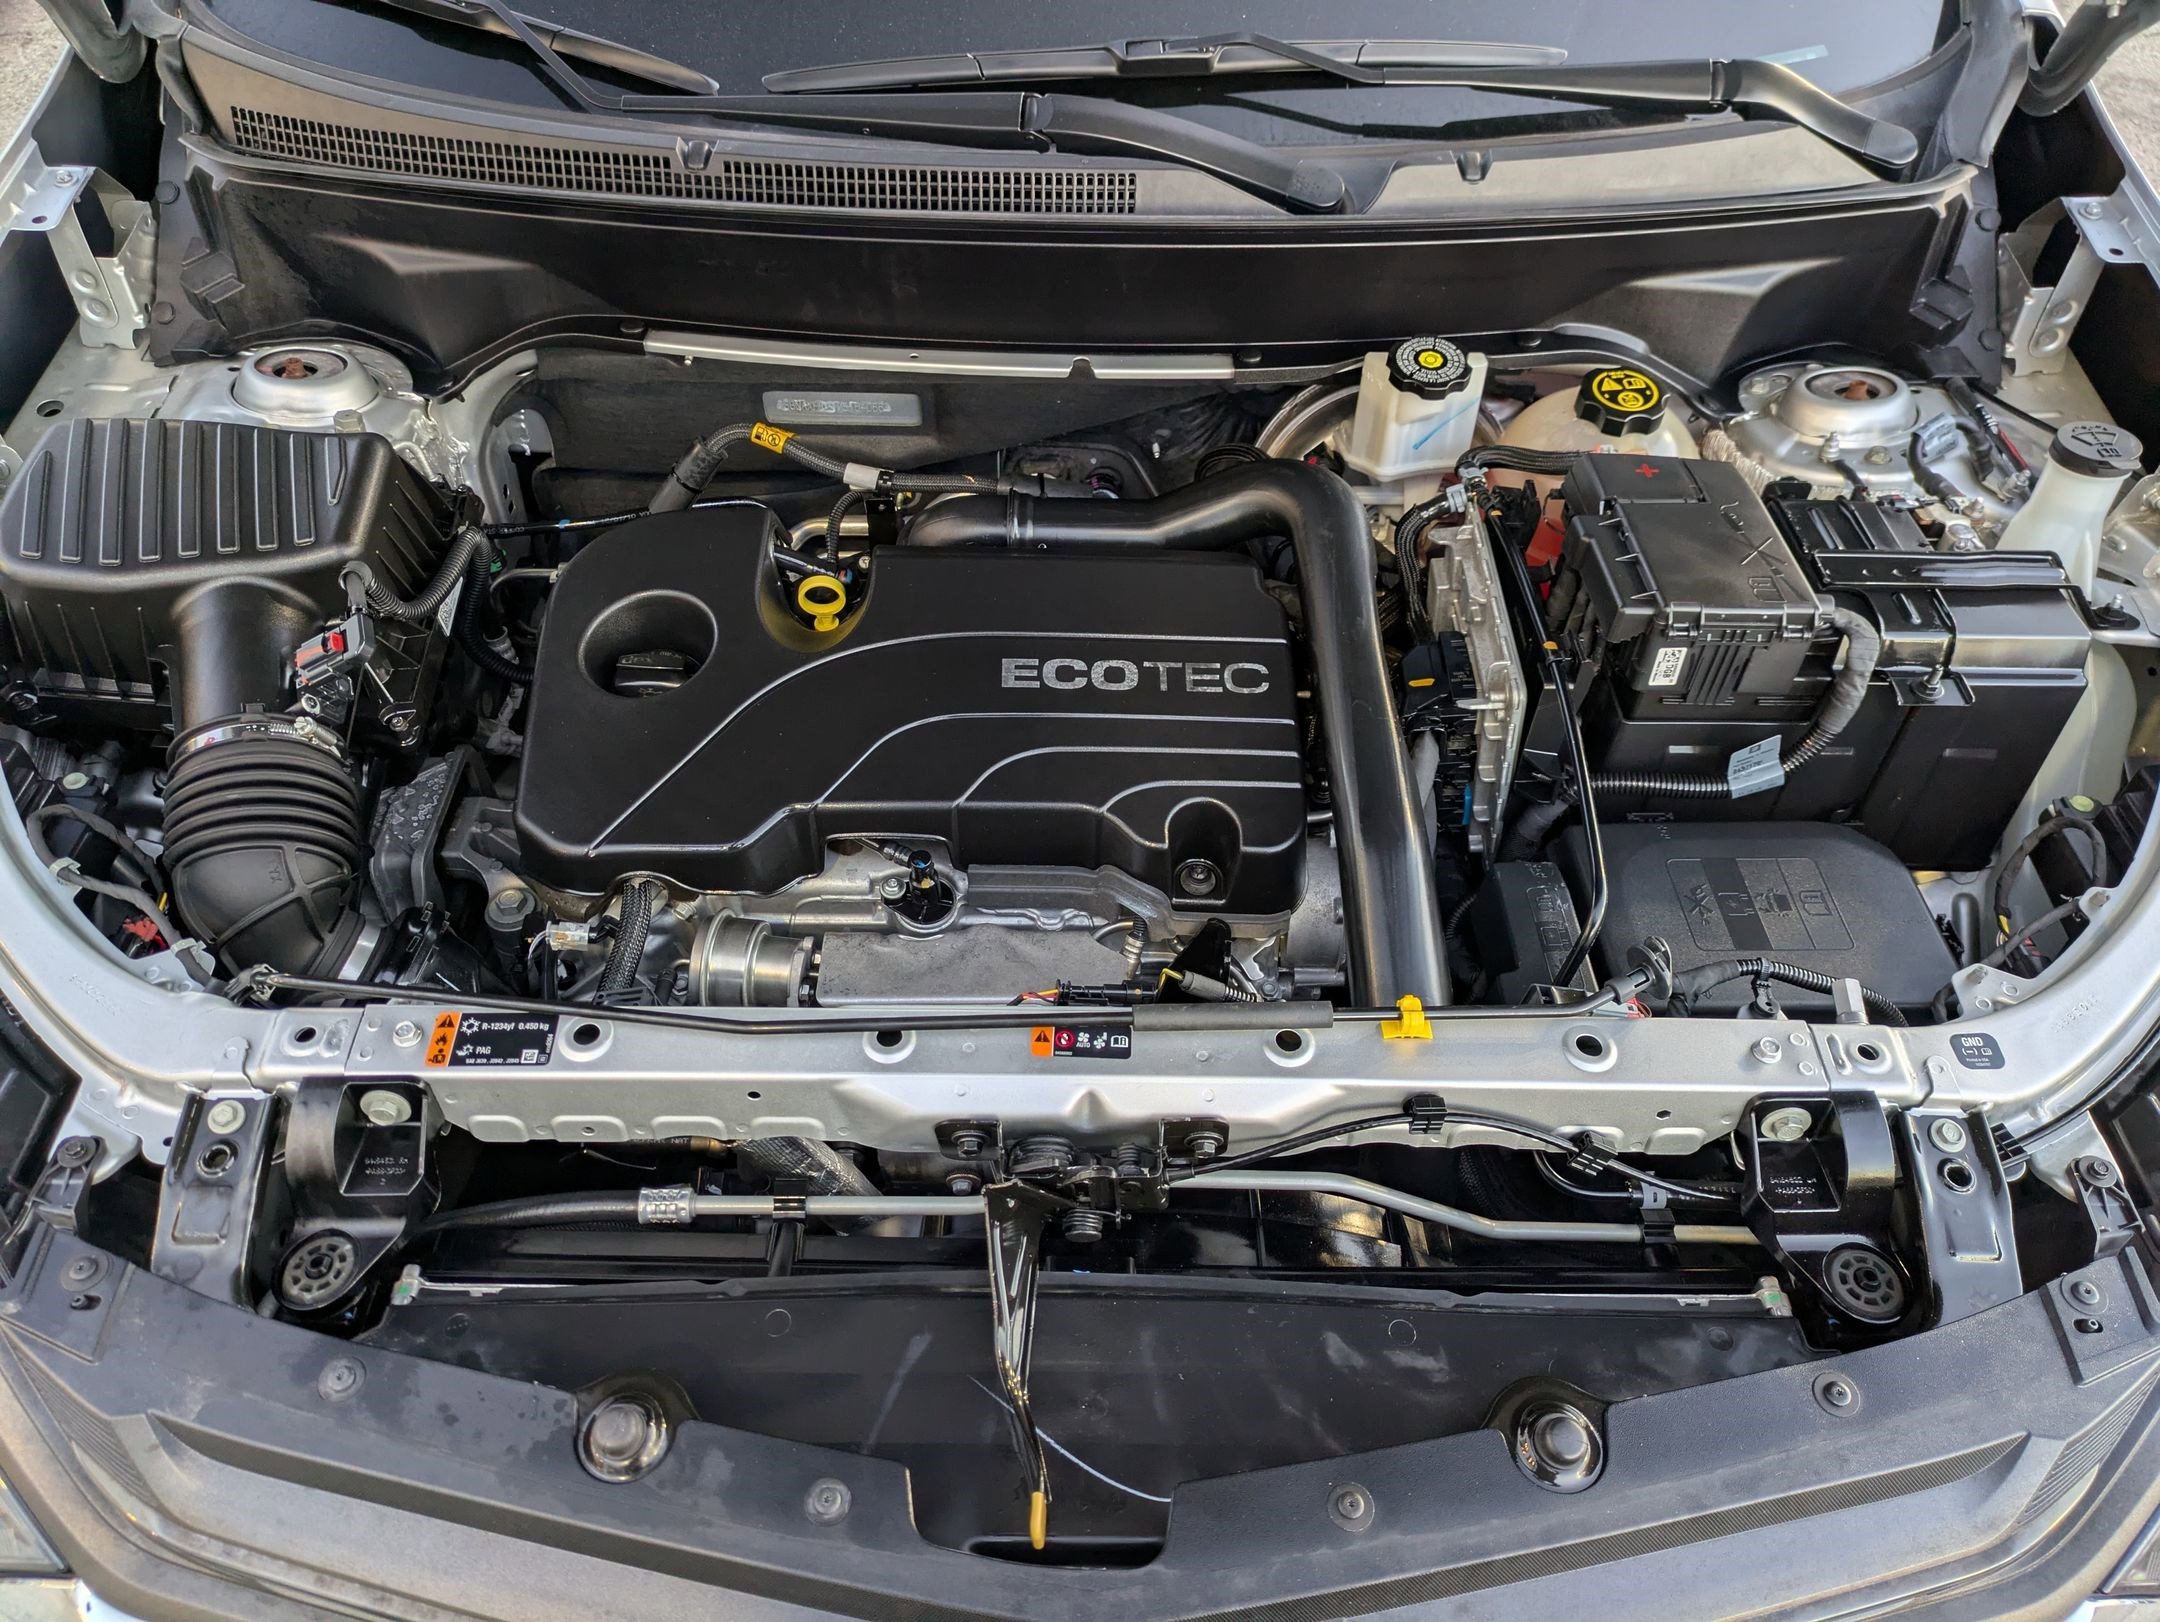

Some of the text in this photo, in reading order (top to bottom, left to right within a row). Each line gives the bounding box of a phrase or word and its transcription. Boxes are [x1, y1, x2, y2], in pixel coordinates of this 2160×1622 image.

[1001, 658, 1269, 694] ECOTEC
[481, 1022, 550, 1031] R-1234yf 0.450 kg
[1961, 1036, 1984, 1047] GND
[475, 1046, 492, 1055] PAG
